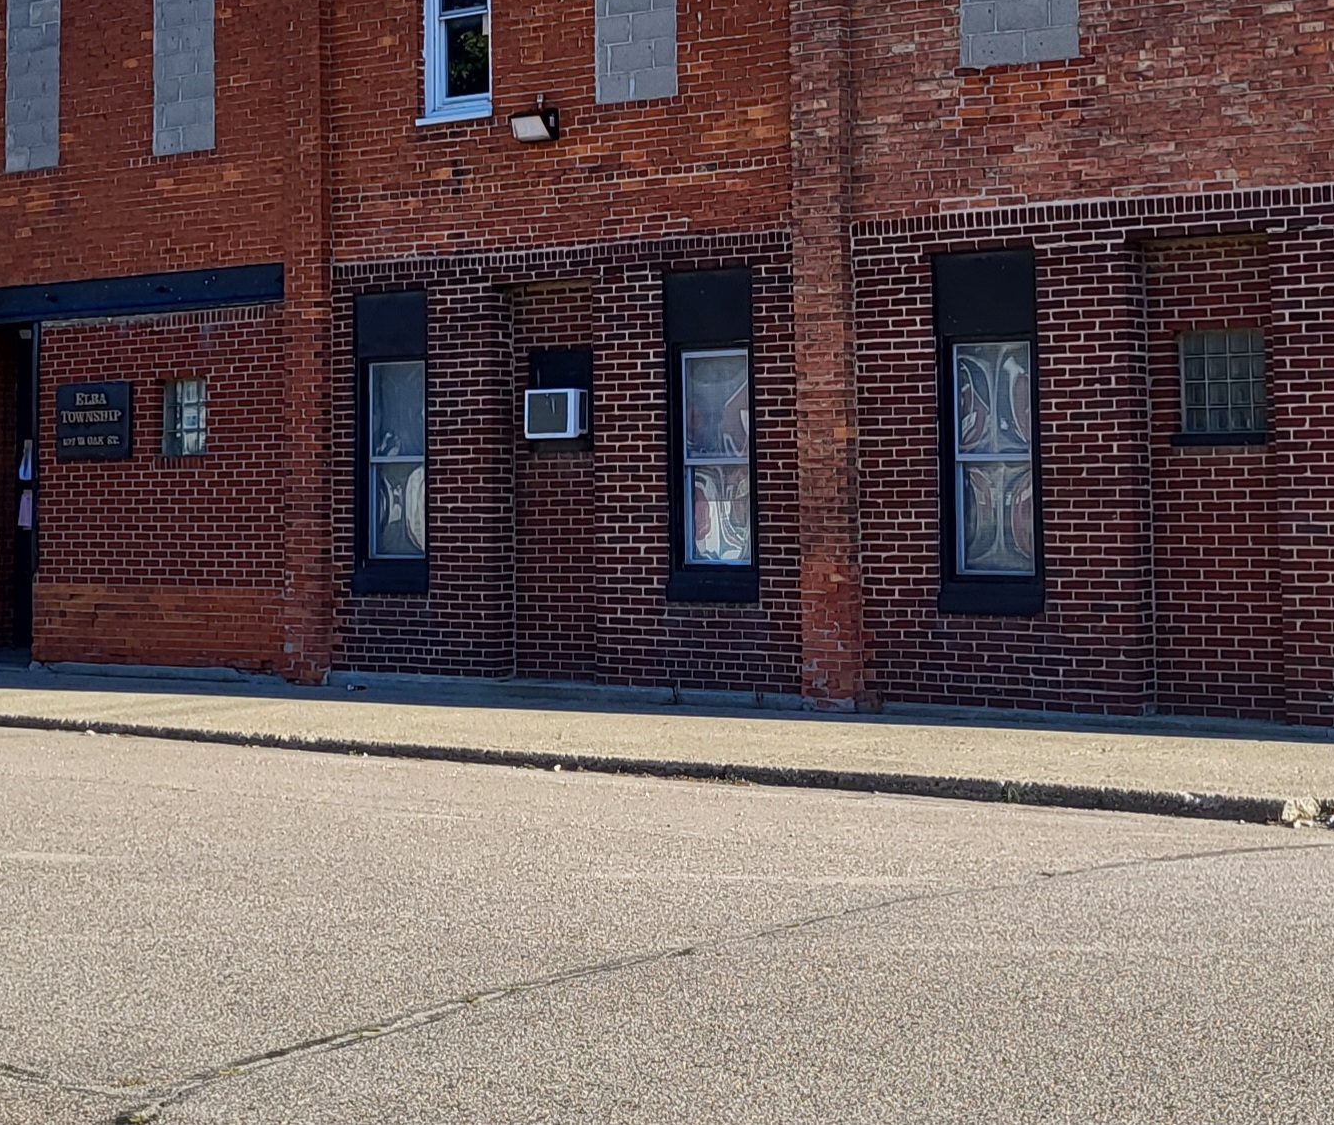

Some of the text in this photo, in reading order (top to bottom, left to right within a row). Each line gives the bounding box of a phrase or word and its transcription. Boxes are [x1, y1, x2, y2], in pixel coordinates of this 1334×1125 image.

[75, 392, 107, 406] ELBA
[60, 409, 122, 424] TOWNSHIP
[87, 436, 105, 446] OAK
